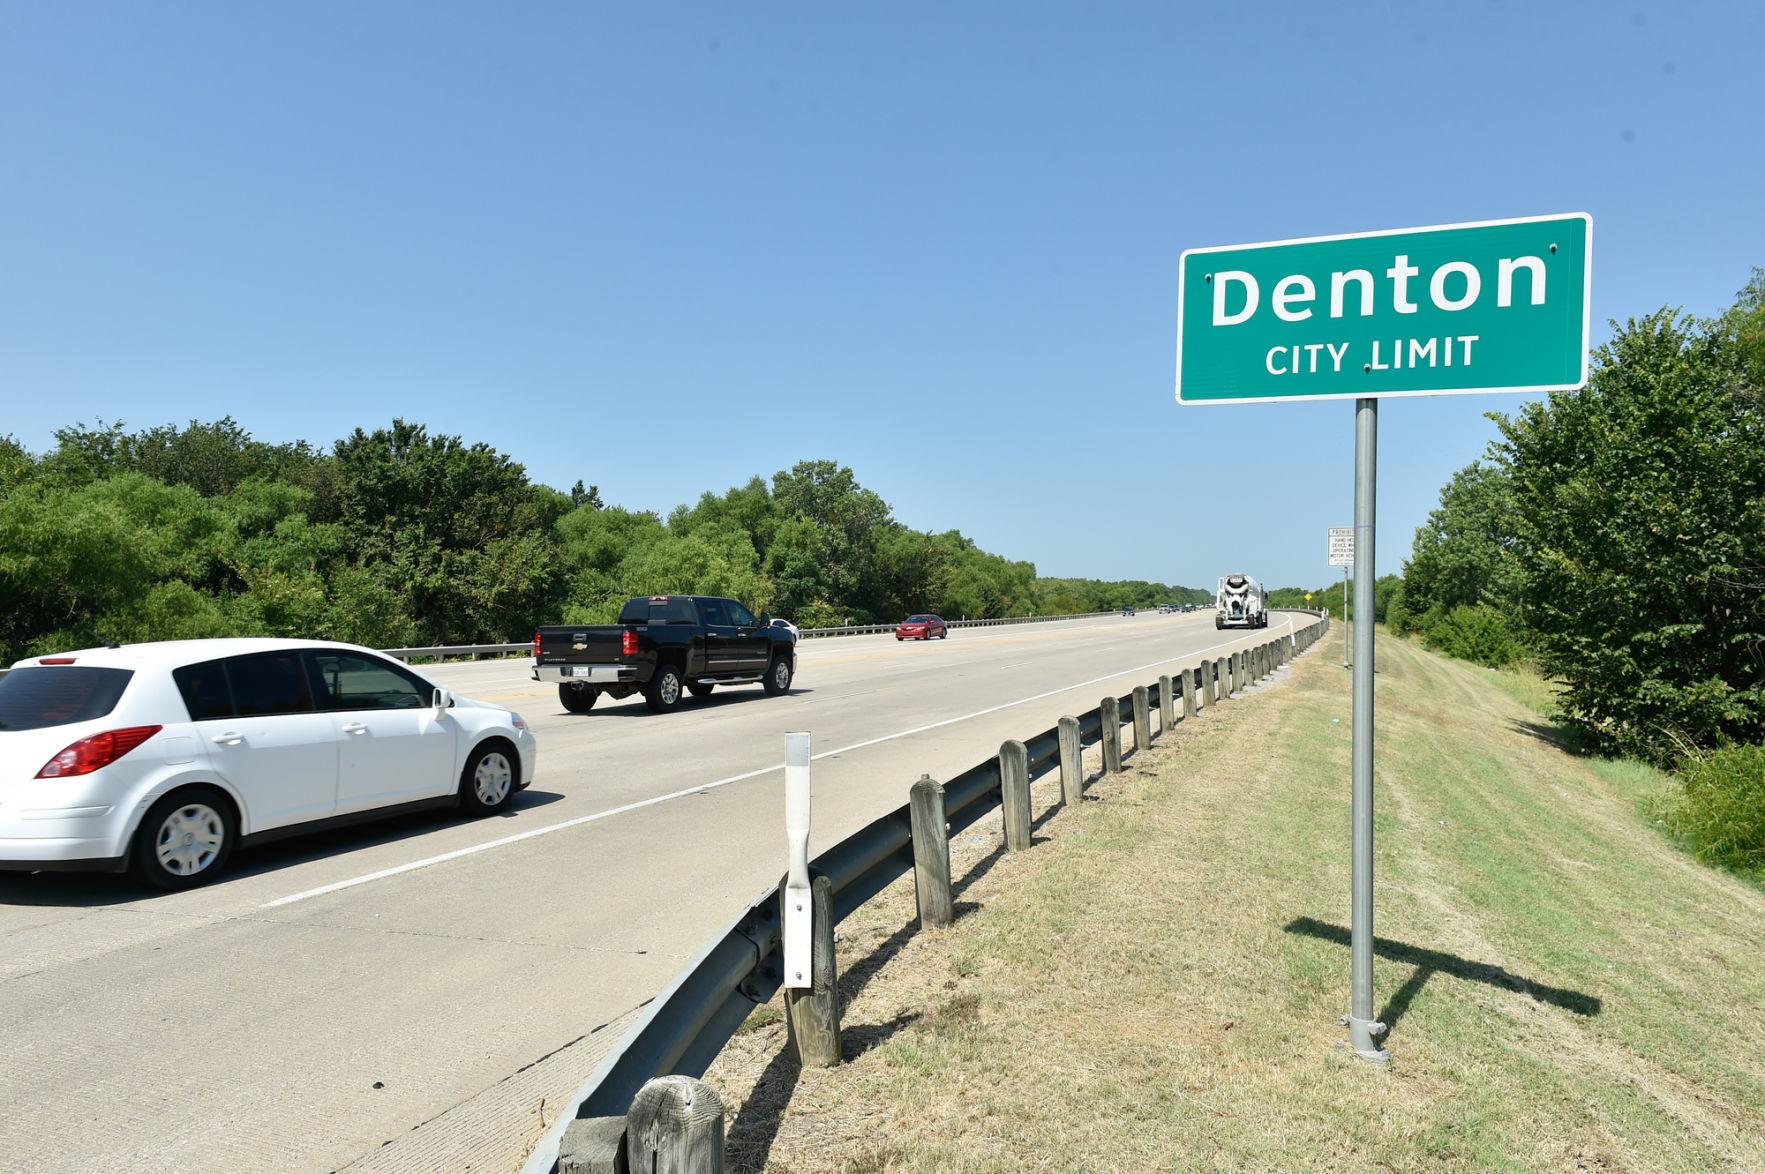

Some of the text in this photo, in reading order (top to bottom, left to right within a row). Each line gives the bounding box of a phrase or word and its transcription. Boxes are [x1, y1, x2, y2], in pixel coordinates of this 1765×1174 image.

[1212, 254, 1547, 327] Denton
[1265, 336, 1480, 375] CITY LIMIT
